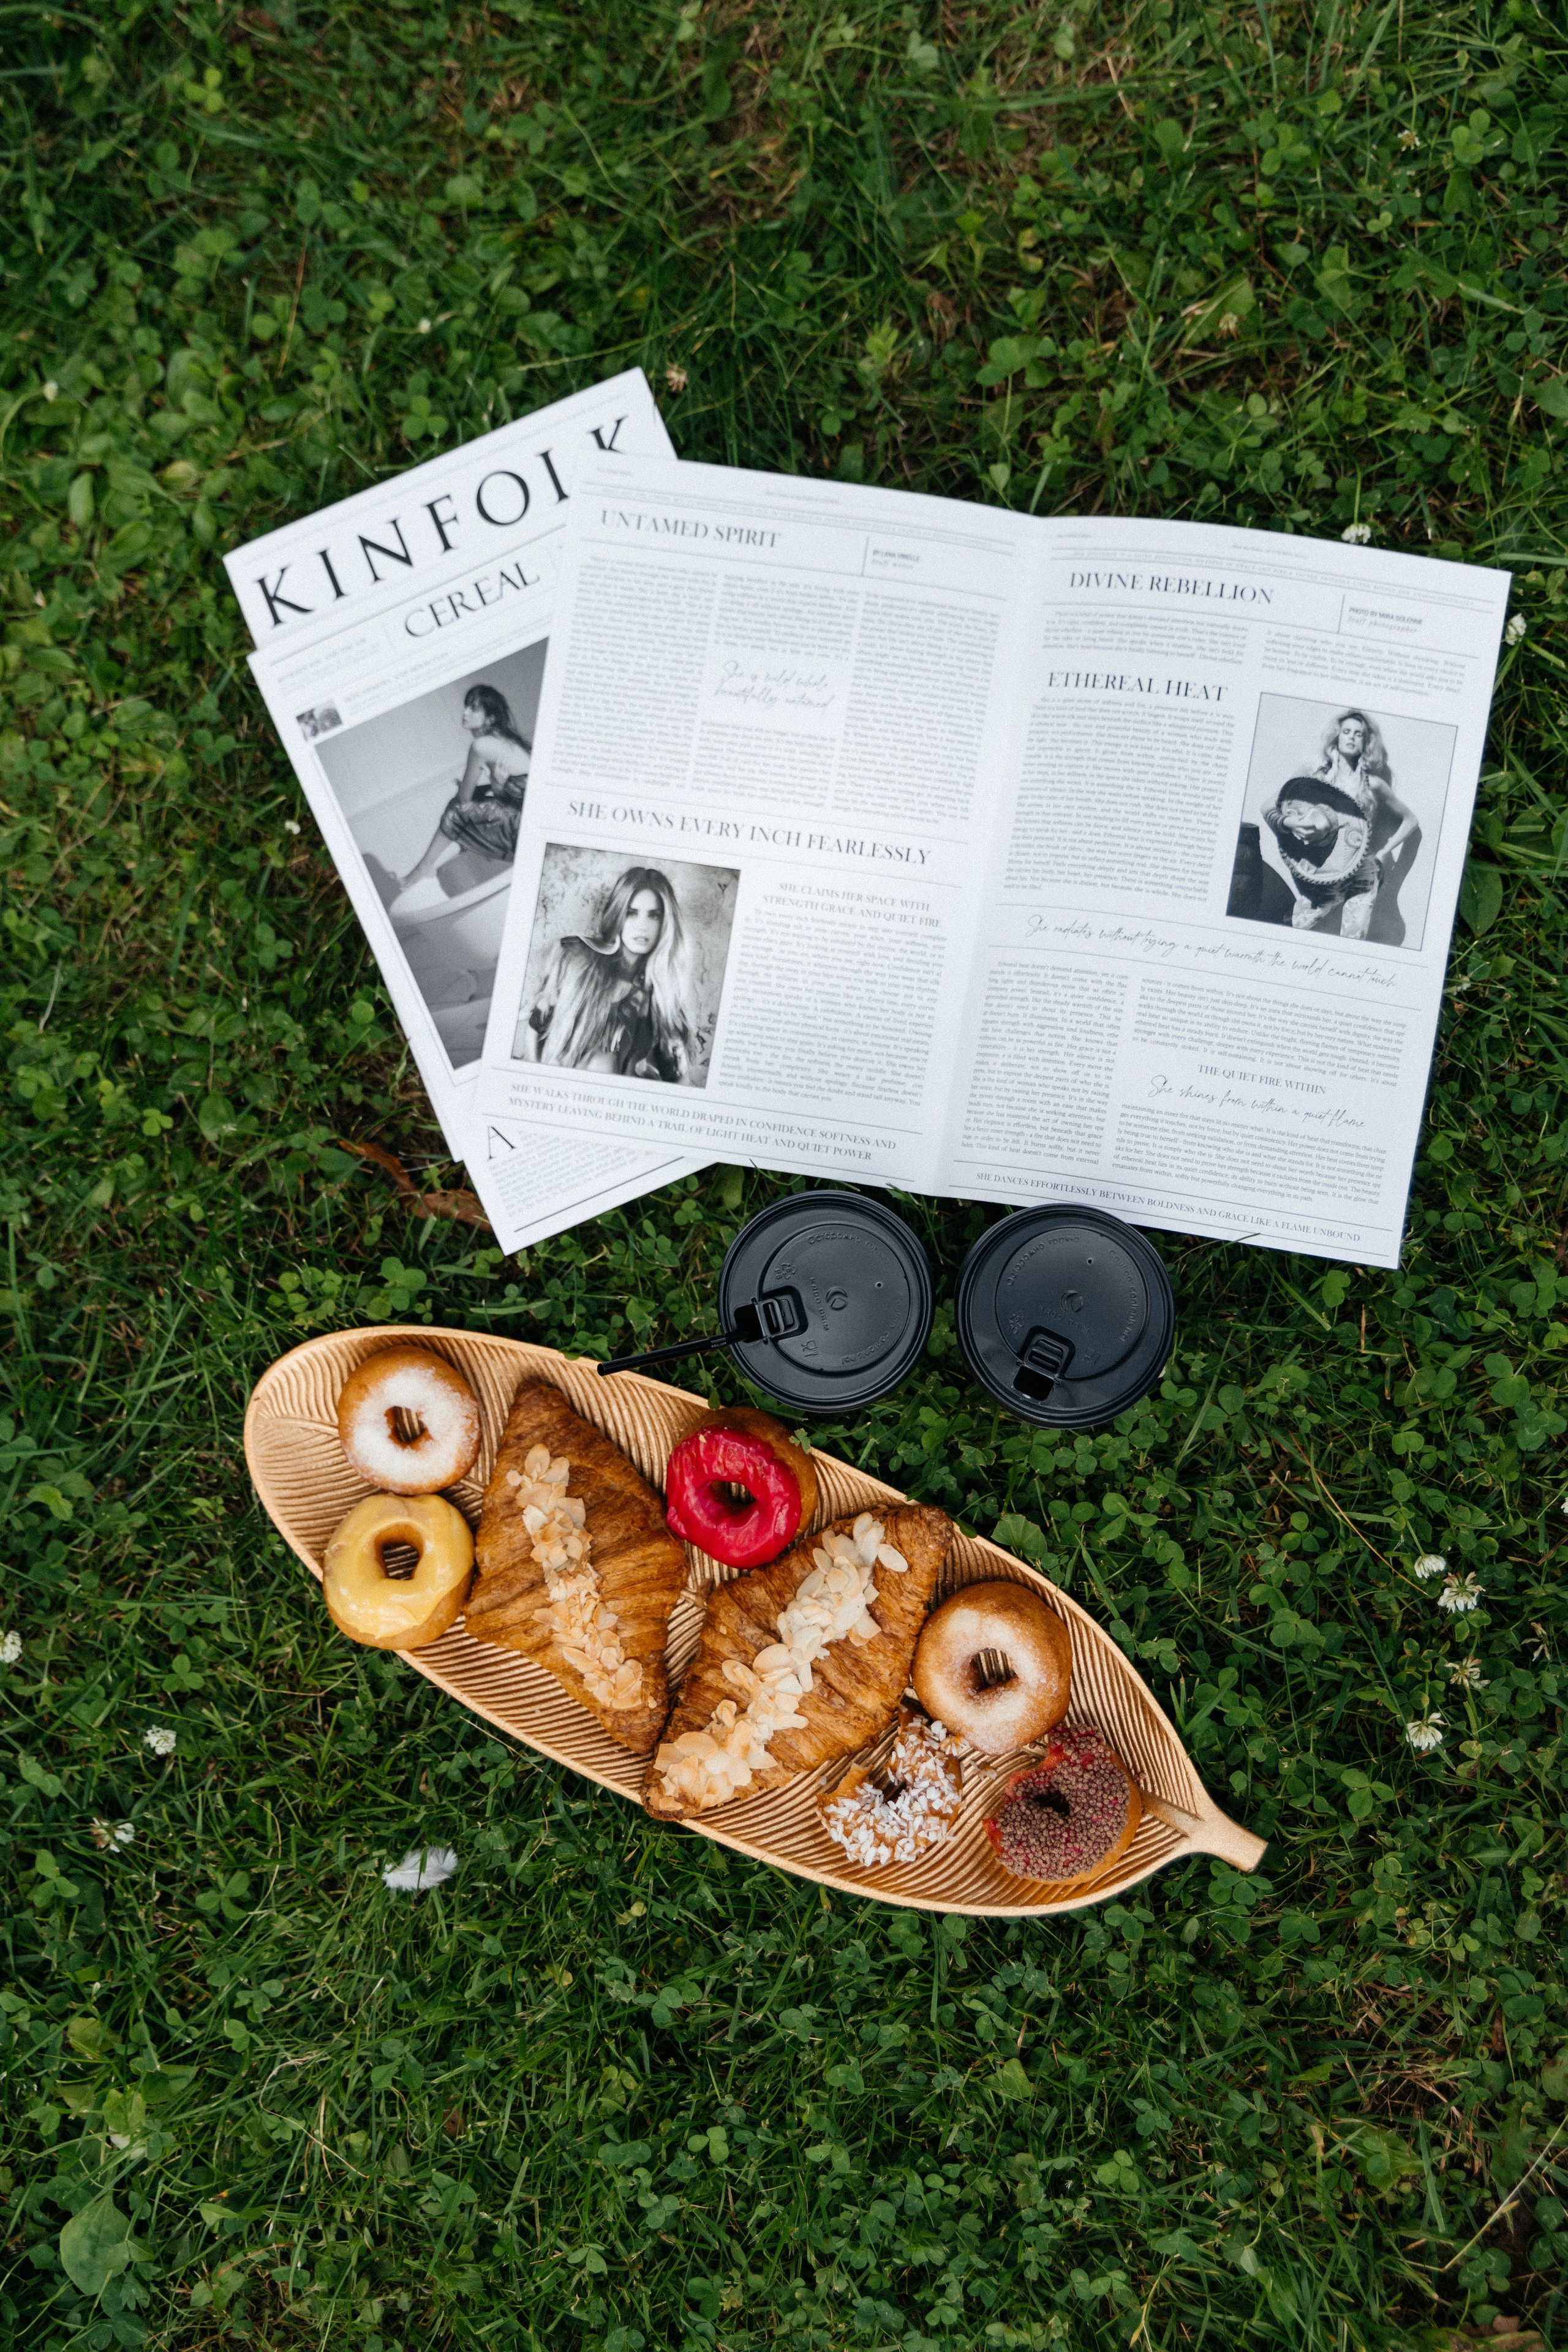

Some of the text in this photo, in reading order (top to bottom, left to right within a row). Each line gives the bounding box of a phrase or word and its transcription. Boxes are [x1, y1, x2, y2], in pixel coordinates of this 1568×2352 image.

[601, 509, 781, 548] UNTAMED SPIRIT
[404, 562, 540, 638] CEREAL
[1069, 571, 1143, 590] DIVINE
[1148, 575, 1273, 604] REBELLION
[1047, 671, 1228, 701] ETHEREAL HEAT
[567, 801, 931, 865] SHE OWNS EVERY INCH FEARLESSLY
[763, 894, 941, 927] STRENGTH GRACE AND QUIET FIRE
[778, 883, 930, 911] SHE CLAIMS HER SPACE WITH
[1025, 914, 1047, 938] She
[1267, 951, 1286, 967] the
[1292, 957, 1329, 978] world
[1328, 967, 1371, 984] cannot
[1368, 968, 1397, 987] touch
[1148, 1074, 1174, 1098] She
[1179, 1085, 1216, 1103] shines
[1219, 1090, 1246, 1107] from
[1251, 1098, 1287, 1114] within
[1302, 1109, 1332, 1122] quiet
[1329, 1109, 1366, 1128] flame
[1197, 1064, 1326, 1094] THE QUIET FIRE WITHIN
[509, 1096, 554, 1111] MYSTERY
[557, 1104, 601, 1118] LEAVING
[605, 1112, 645, 1125] BEHIND
[657, 1120, 687, 1132] TRAIL
[687, 1125, 704, 1134] OF
[706, 1127, 739, 1139] LIGHT
[741, 1133, 771, 1144] HEAT
[772, 1138, 795, 1148] AND
[797, 1141, 831, 1153] QUIET
[833, 1146, 871, 1160] POWER
[511, 1084, 896, 1149] SHE WALKS THROUGH THE WORLD DRAPED IN CONFIDENCE SOFTNESS AND
[993, 1174, 1028, 1185] DANCES
[1030, 1179, 1097, 1196] EFFORTLESSLY
[1099, 1189, 1145, 1204] BETWEEN
[1147, 1198, 1194, 1212] BOLDNESS
[1196, 1207, 1216, 1216] AND
[1218, 1210, 1248, 1222] GRACE
[1250, 1216, 1271, 1226] LIKE
[1281, 1221, 1311, 1233] FLAME
[1313, 1227, 1360, 1241] UNBOUND
